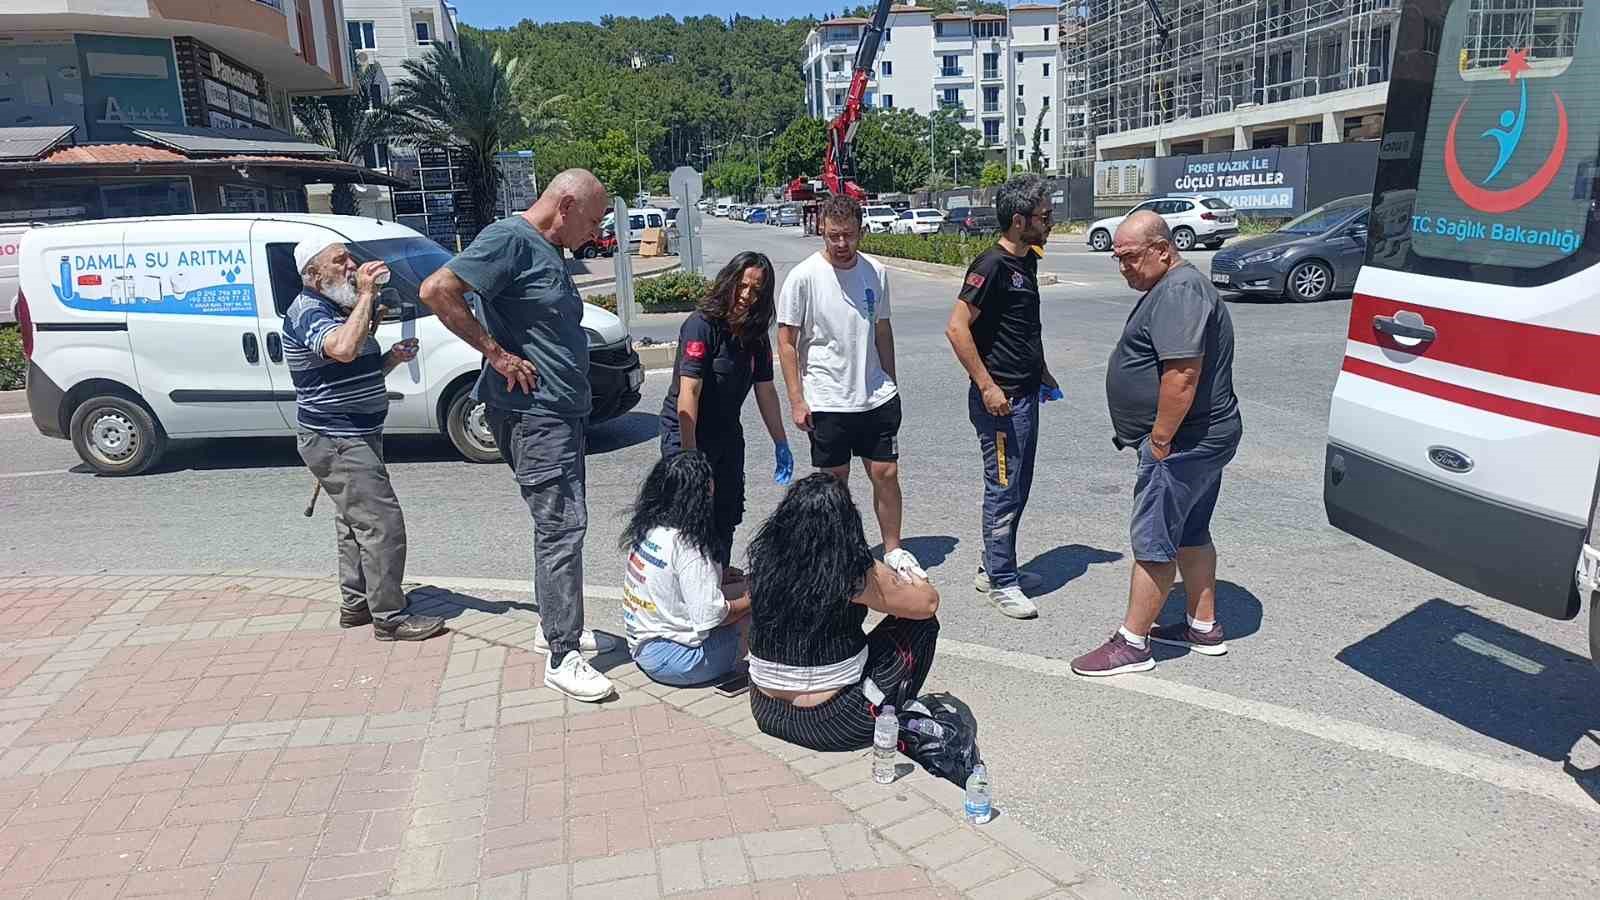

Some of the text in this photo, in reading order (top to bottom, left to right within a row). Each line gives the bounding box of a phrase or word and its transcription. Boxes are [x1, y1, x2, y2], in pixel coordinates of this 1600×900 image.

[1188, 156, 1269, 174] FORE KAZIK İLE
[1175, 172, 1284, 191] GÜÇLÜ TEMELLER
[1222, 193, 1289, 208] YARINLAR
[1435, 217, 1487, 241] Sağlık
[1491, 223, 1582, 252] Bakanlığı
[75, 250, 247, 271] DAMLA SU ARITMA
